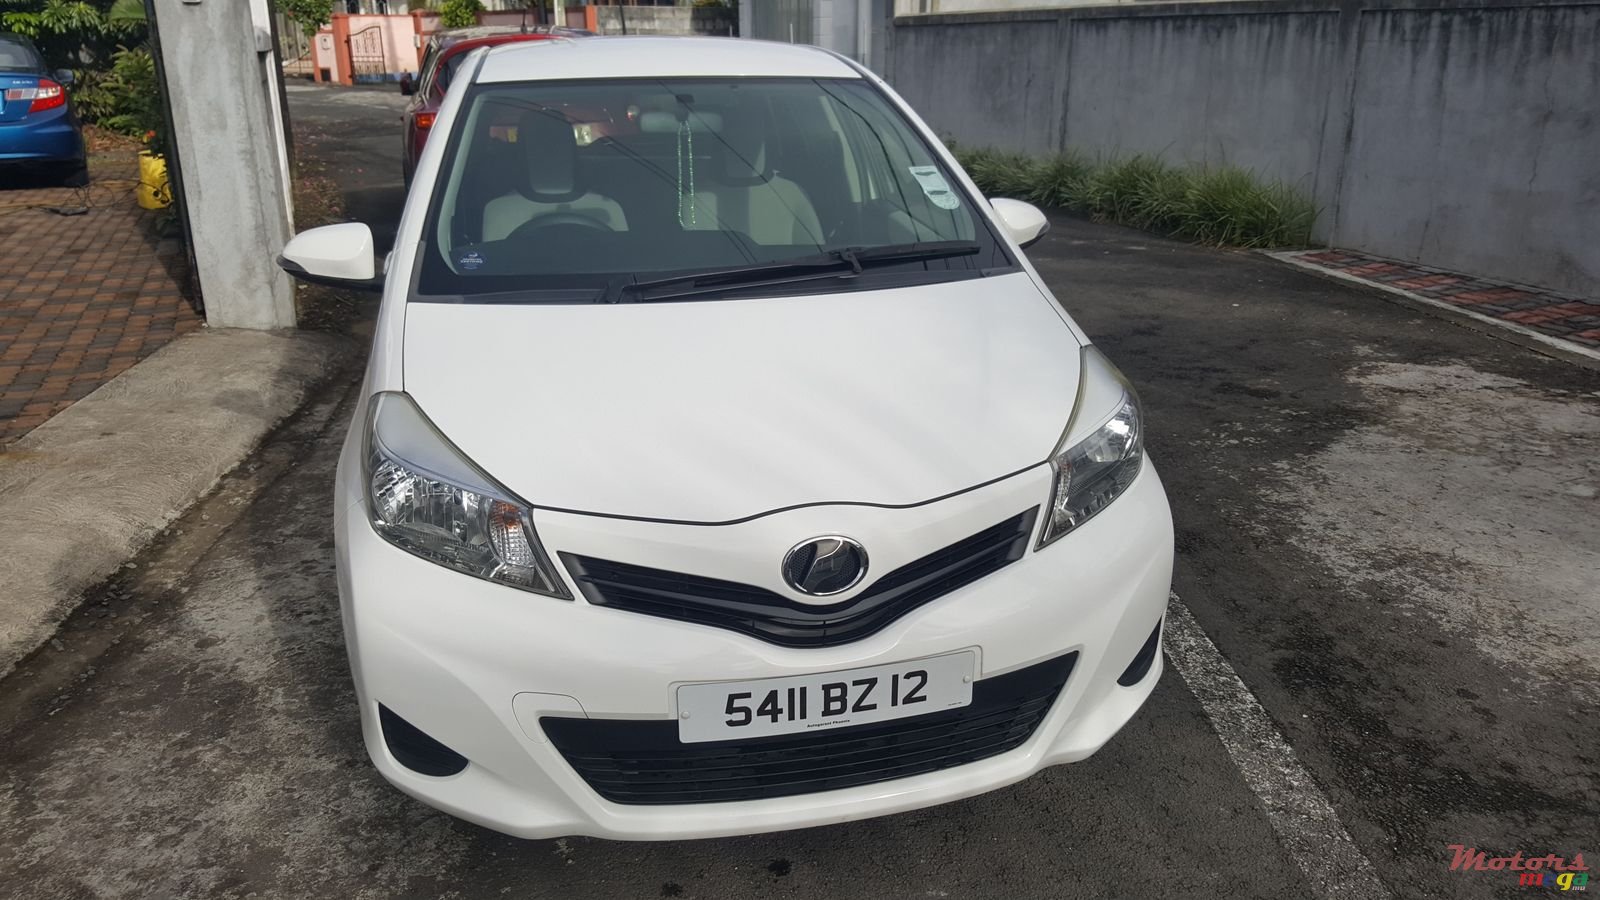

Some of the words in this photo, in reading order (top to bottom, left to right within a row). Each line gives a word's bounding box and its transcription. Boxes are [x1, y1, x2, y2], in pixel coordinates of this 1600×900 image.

[725, 686, 807, 728] 5411
[821, 677, 878, 717] BZ
[891, 669, 928, 707] 12
